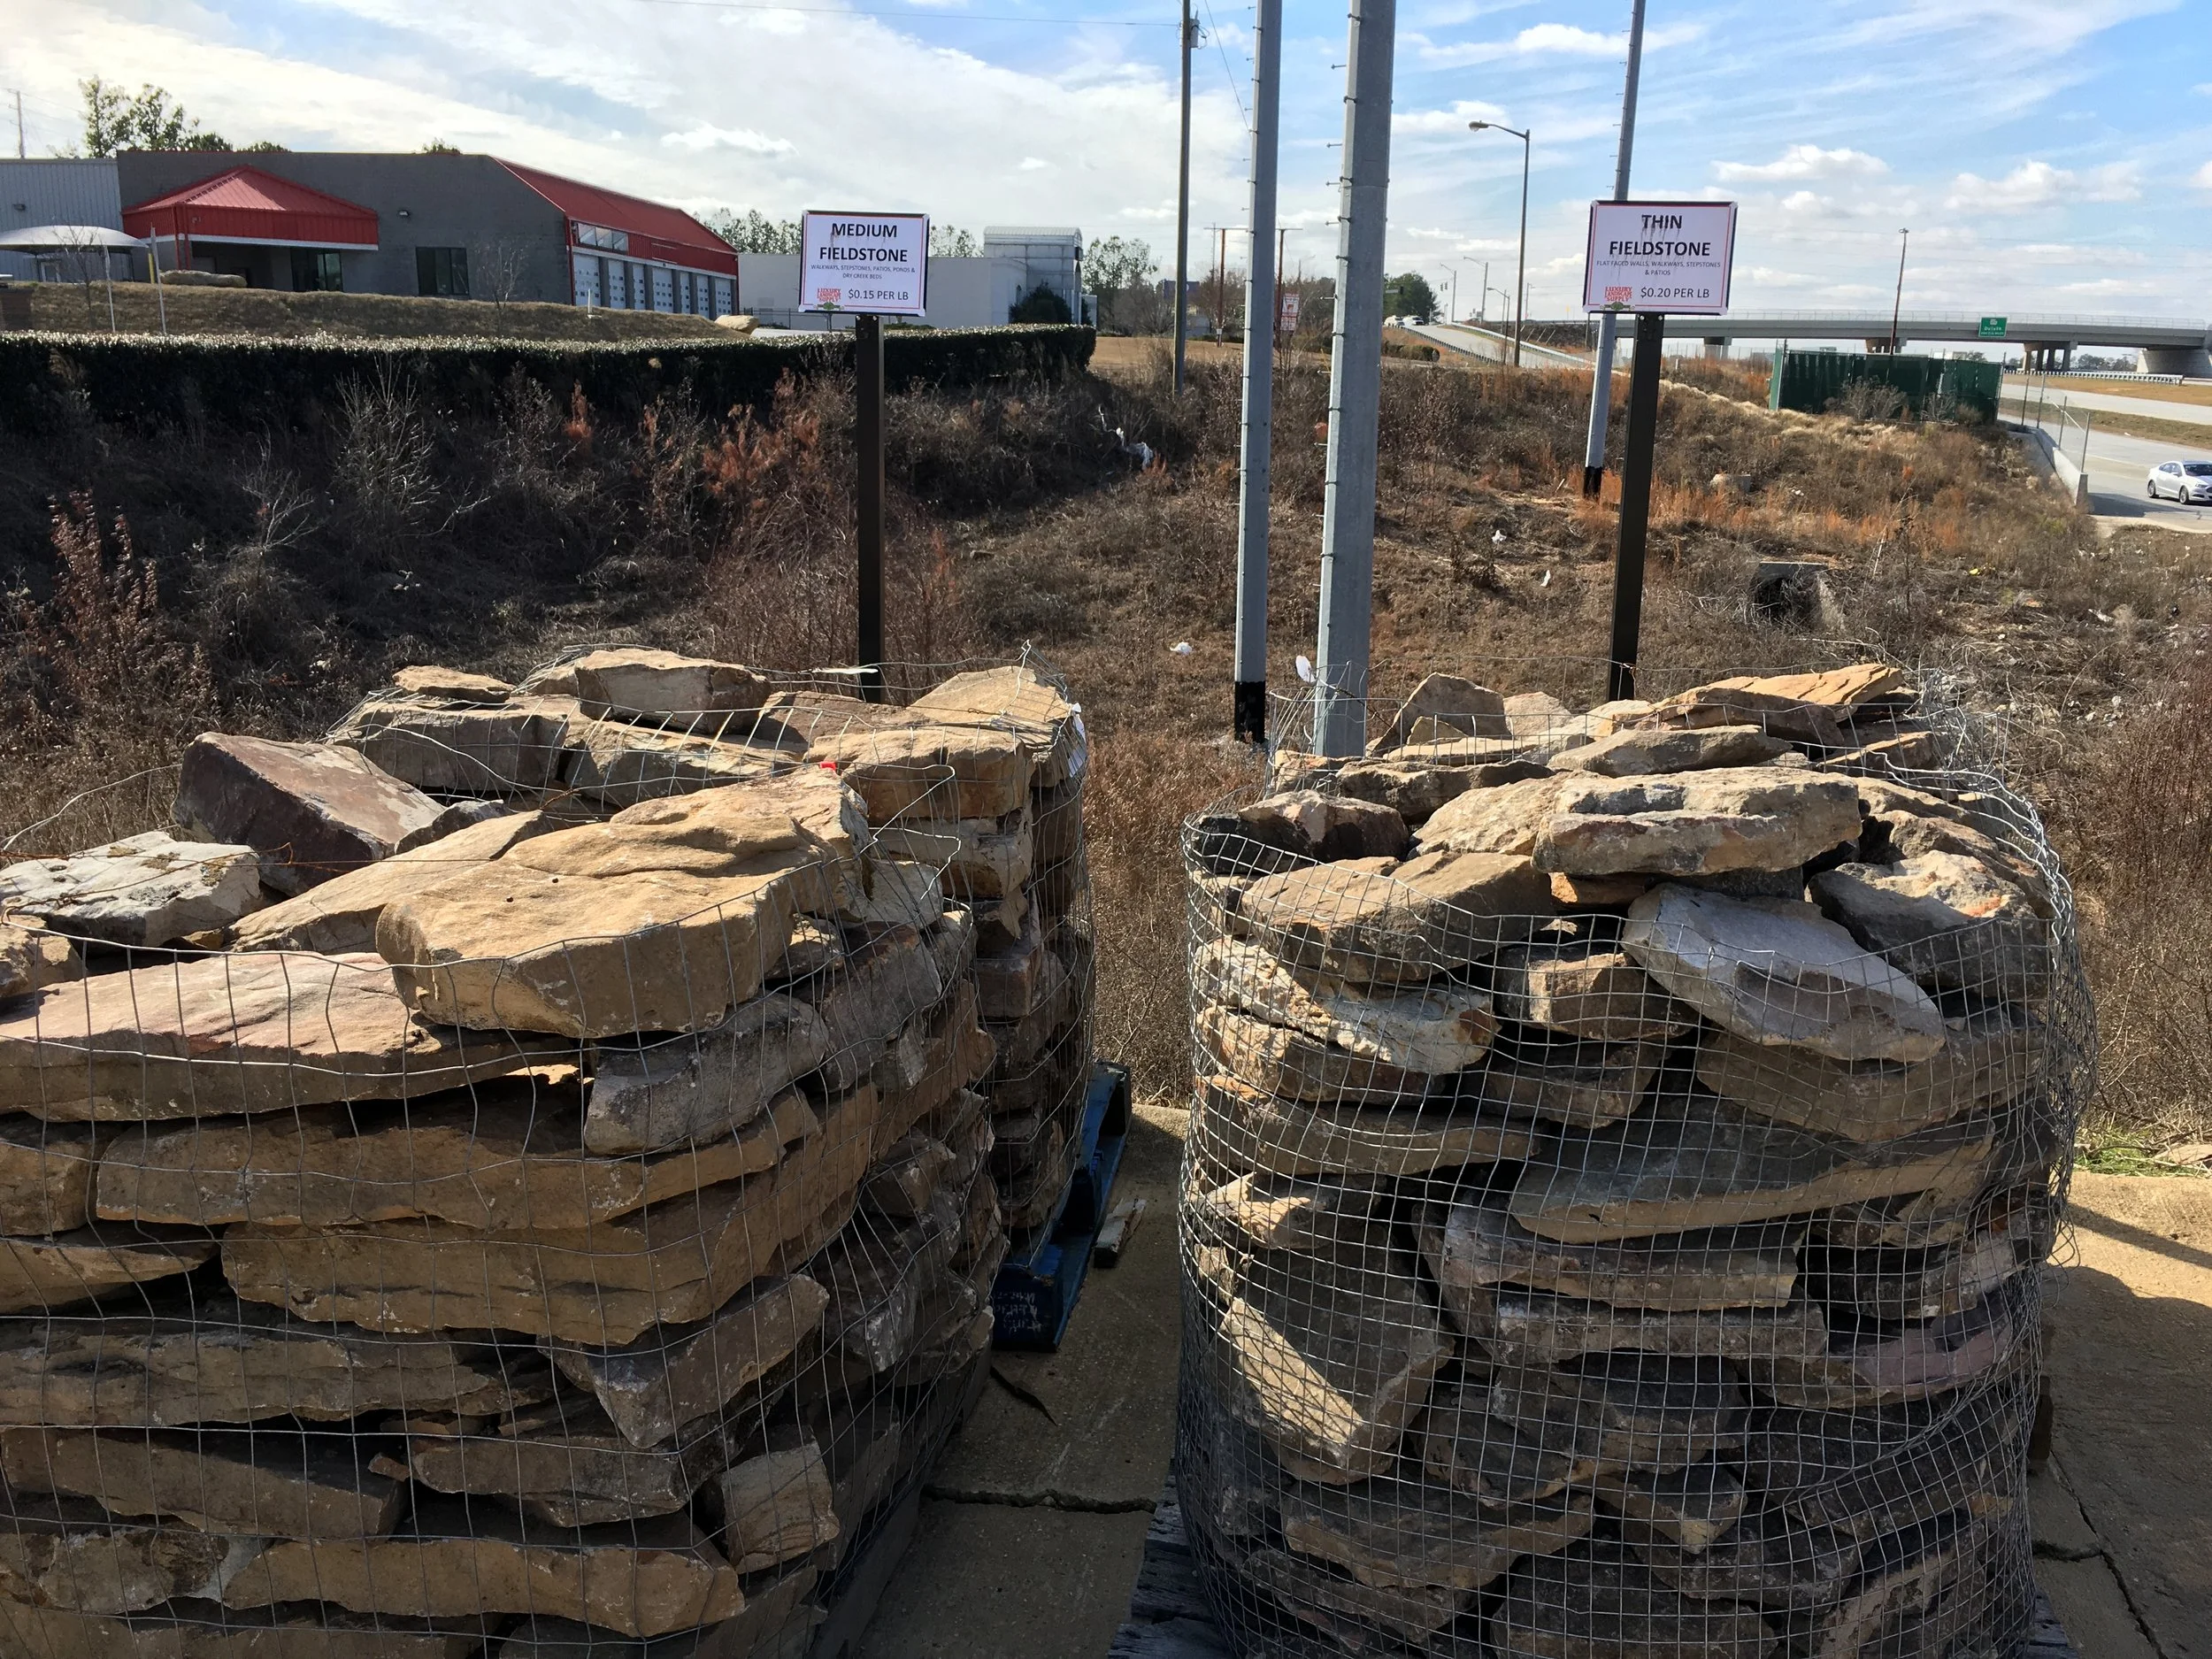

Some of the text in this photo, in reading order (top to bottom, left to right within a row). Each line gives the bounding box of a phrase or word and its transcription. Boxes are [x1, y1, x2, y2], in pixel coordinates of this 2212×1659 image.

[1641, 215, 1682, 228] THIN
[832, 223, 897, 237] MEDIUM
[819, 247, 908, 262] FIELDSTONE
[1609, 242, 1710, 256] FIELDSTONE
[848, 288, 909, 300] $0.15 PER LB
[1640, 287, 1709, 298] $0.20 PER LB
